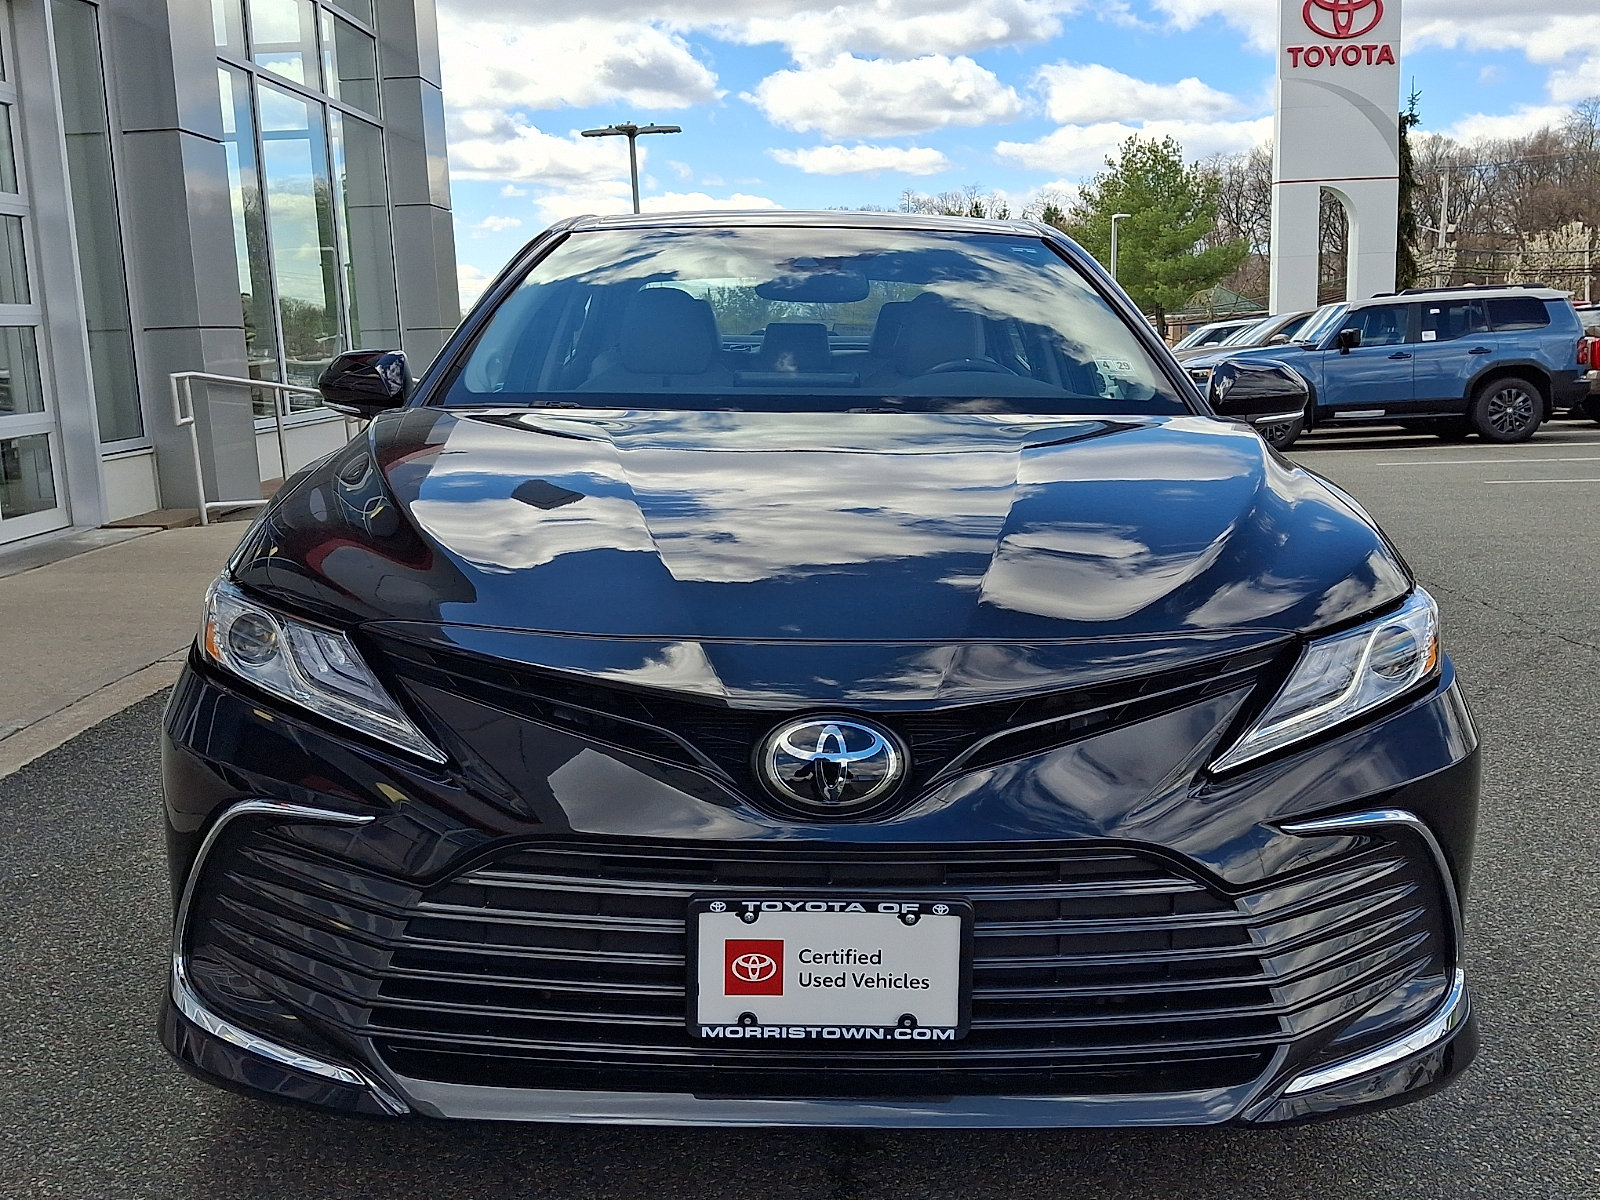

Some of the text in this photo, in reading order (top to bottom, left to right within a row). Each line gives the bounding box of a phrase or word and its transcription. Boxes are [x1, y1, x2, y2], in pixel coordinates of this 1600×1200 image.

[1287, 44, 1395, 68] TOYOTA
[1103, 361, 1130, 371] 4 29
[742, 901, 919, 914] TOYOTA OF
[798, 949, 882, 966] Certified
[798, 972, 930, 990] Used Vehicles
[701, 1026, 955, 1040] MORRISTOWN.COM
